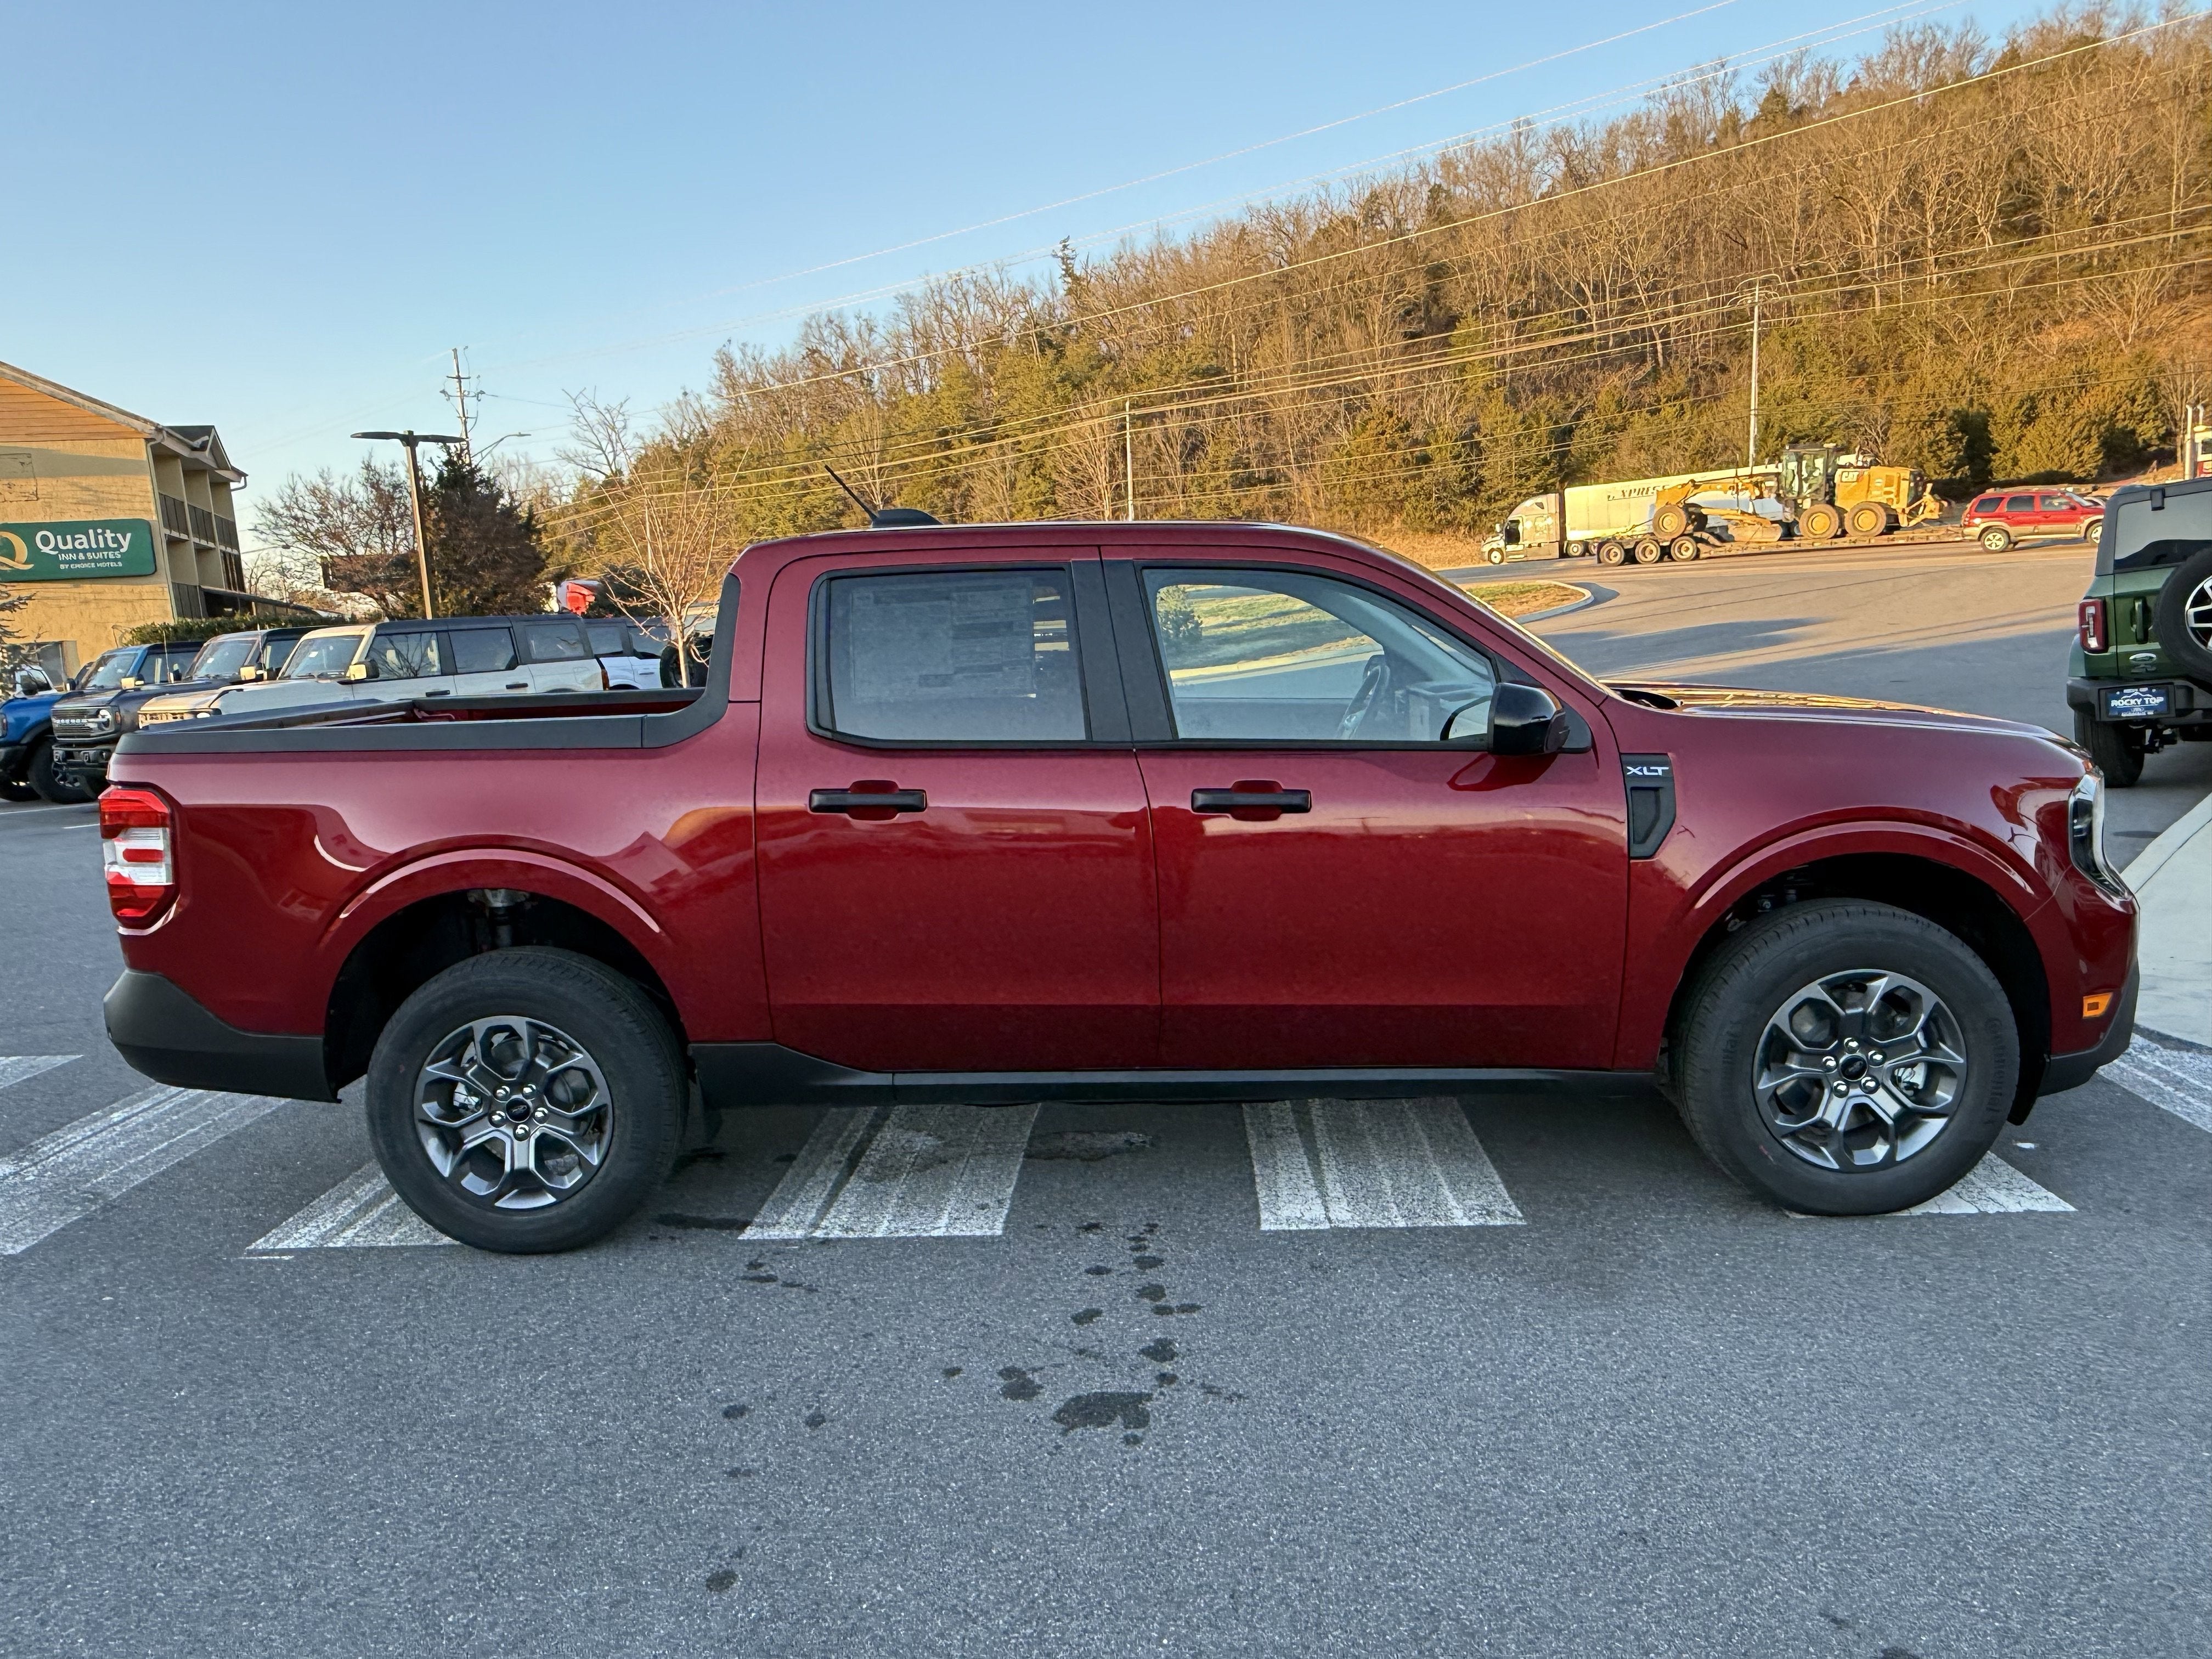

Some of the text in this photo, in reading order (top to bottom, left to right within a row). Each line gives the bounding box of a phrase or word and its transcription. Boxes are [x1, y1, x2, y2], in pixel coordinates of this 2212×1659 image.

[35, 528, 132, 555] Quality
[87, 551, 121, 559] SUITES
[2111, 698, 2142, 707] ROCKY
[1626, 766, 1669, 775] XLT
